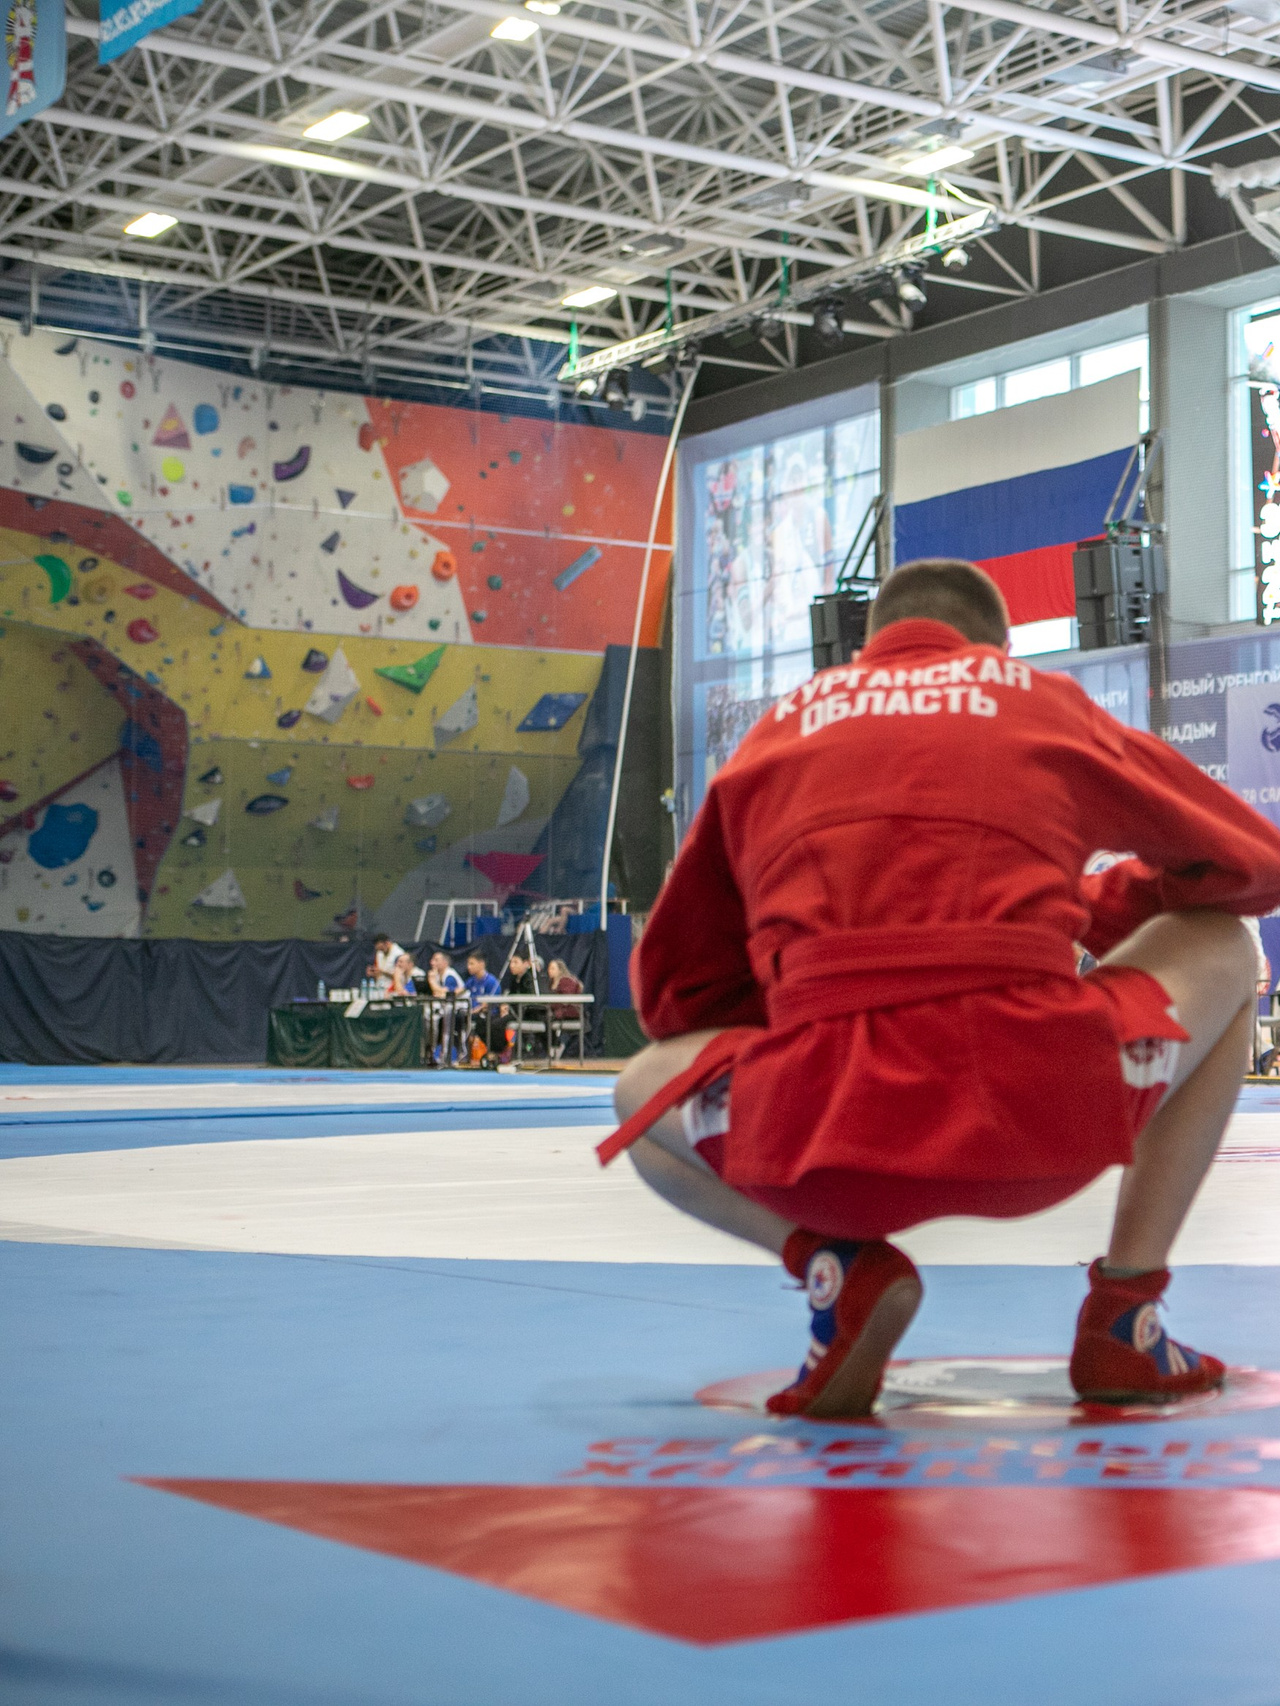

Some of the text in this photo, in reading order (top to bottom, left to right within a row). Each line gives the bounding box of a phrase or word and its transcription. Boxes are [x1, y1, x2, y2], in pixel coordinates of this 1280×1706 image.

[774, 656, 1032, 722] КУРГАНСКАЯ
[1161, 673, 1214, 699] НОВЫЙ
[801, 685, 998, 737] ОБЛАСТЬ
[1161, 722, 1217, 744] НАДЫМ
